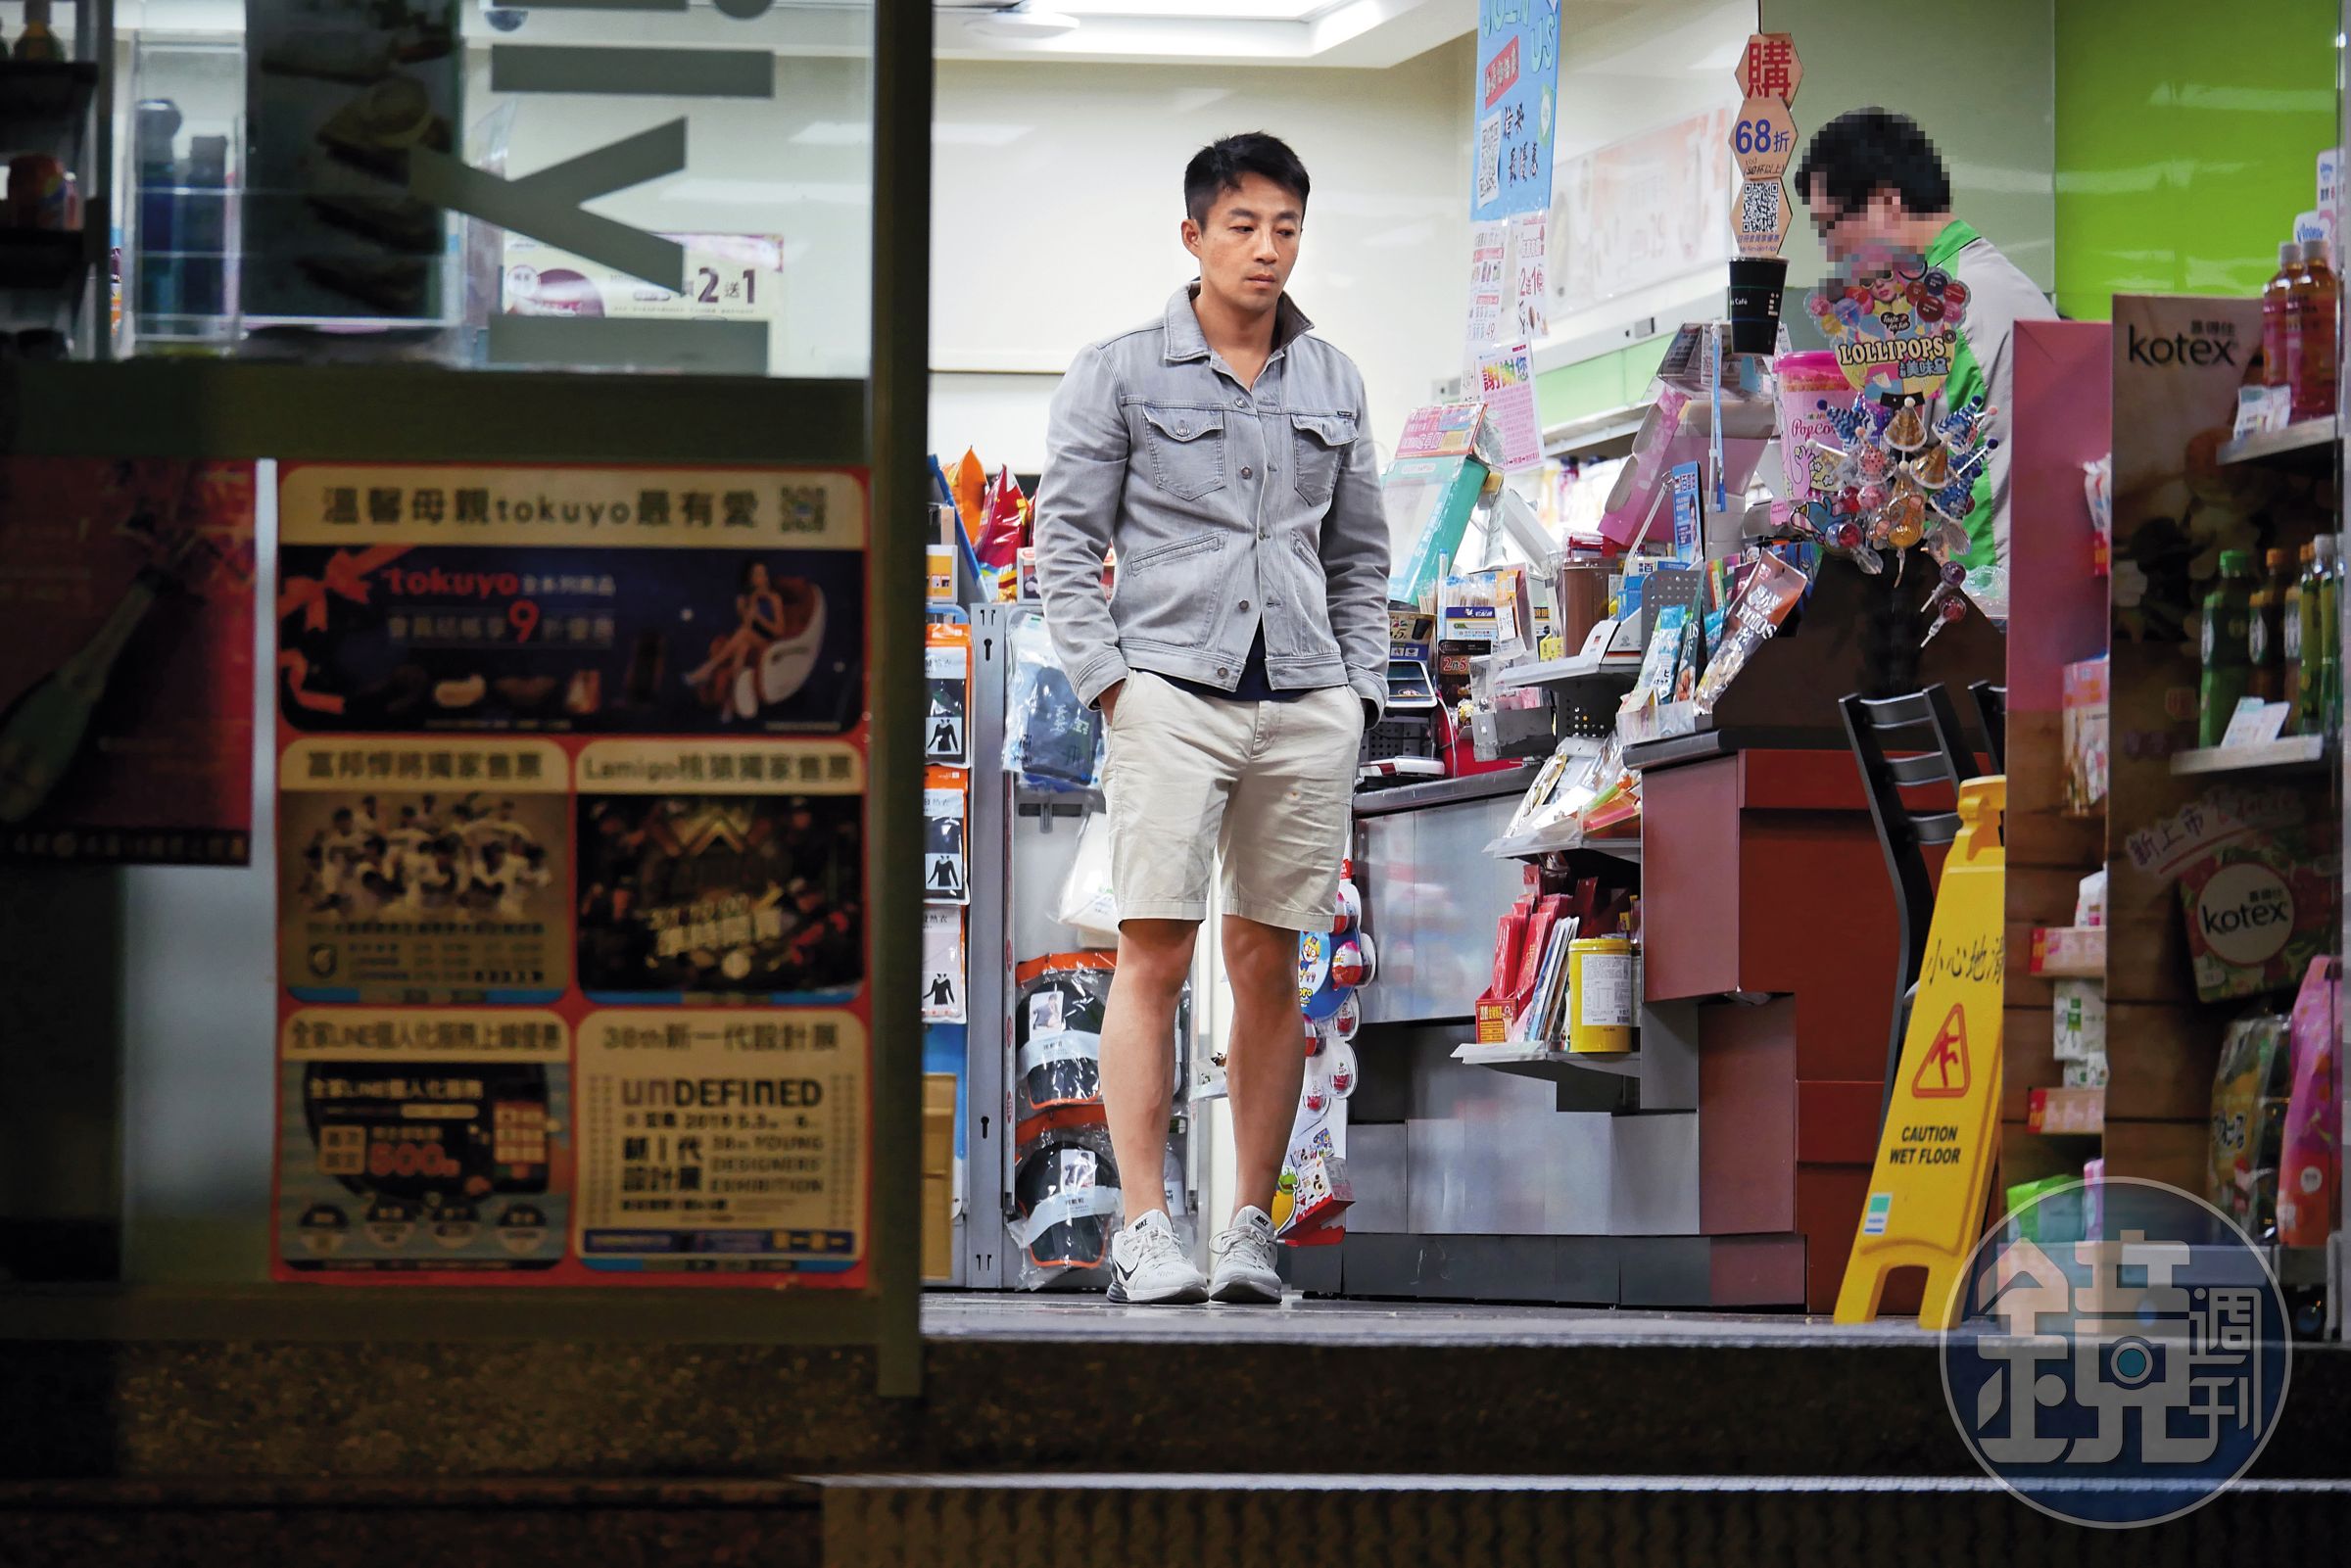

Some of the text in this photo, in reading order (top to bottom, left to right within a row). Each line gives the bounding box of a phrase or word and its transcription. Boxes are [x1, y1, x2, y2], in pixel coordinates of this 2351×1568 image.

[1530, 12, 1556, 73] US
[1747, 40, 1792, 99] 購
[1735, 119, 1791, 155] 68折
[1839, 336, 1946, 366] LOLLIPOPS
[2128, 324, 2237, 367] kotex
[1481, 355, 1529, 391] 謝謝您
[2202, 902, 2289, 934] kotex
[1901, 1125, 1958, 1143] CAUTION
[1889, 1147, 1962, 1164] WET FLOOR
[1255, 1214, 1270, 1226] NIKE
